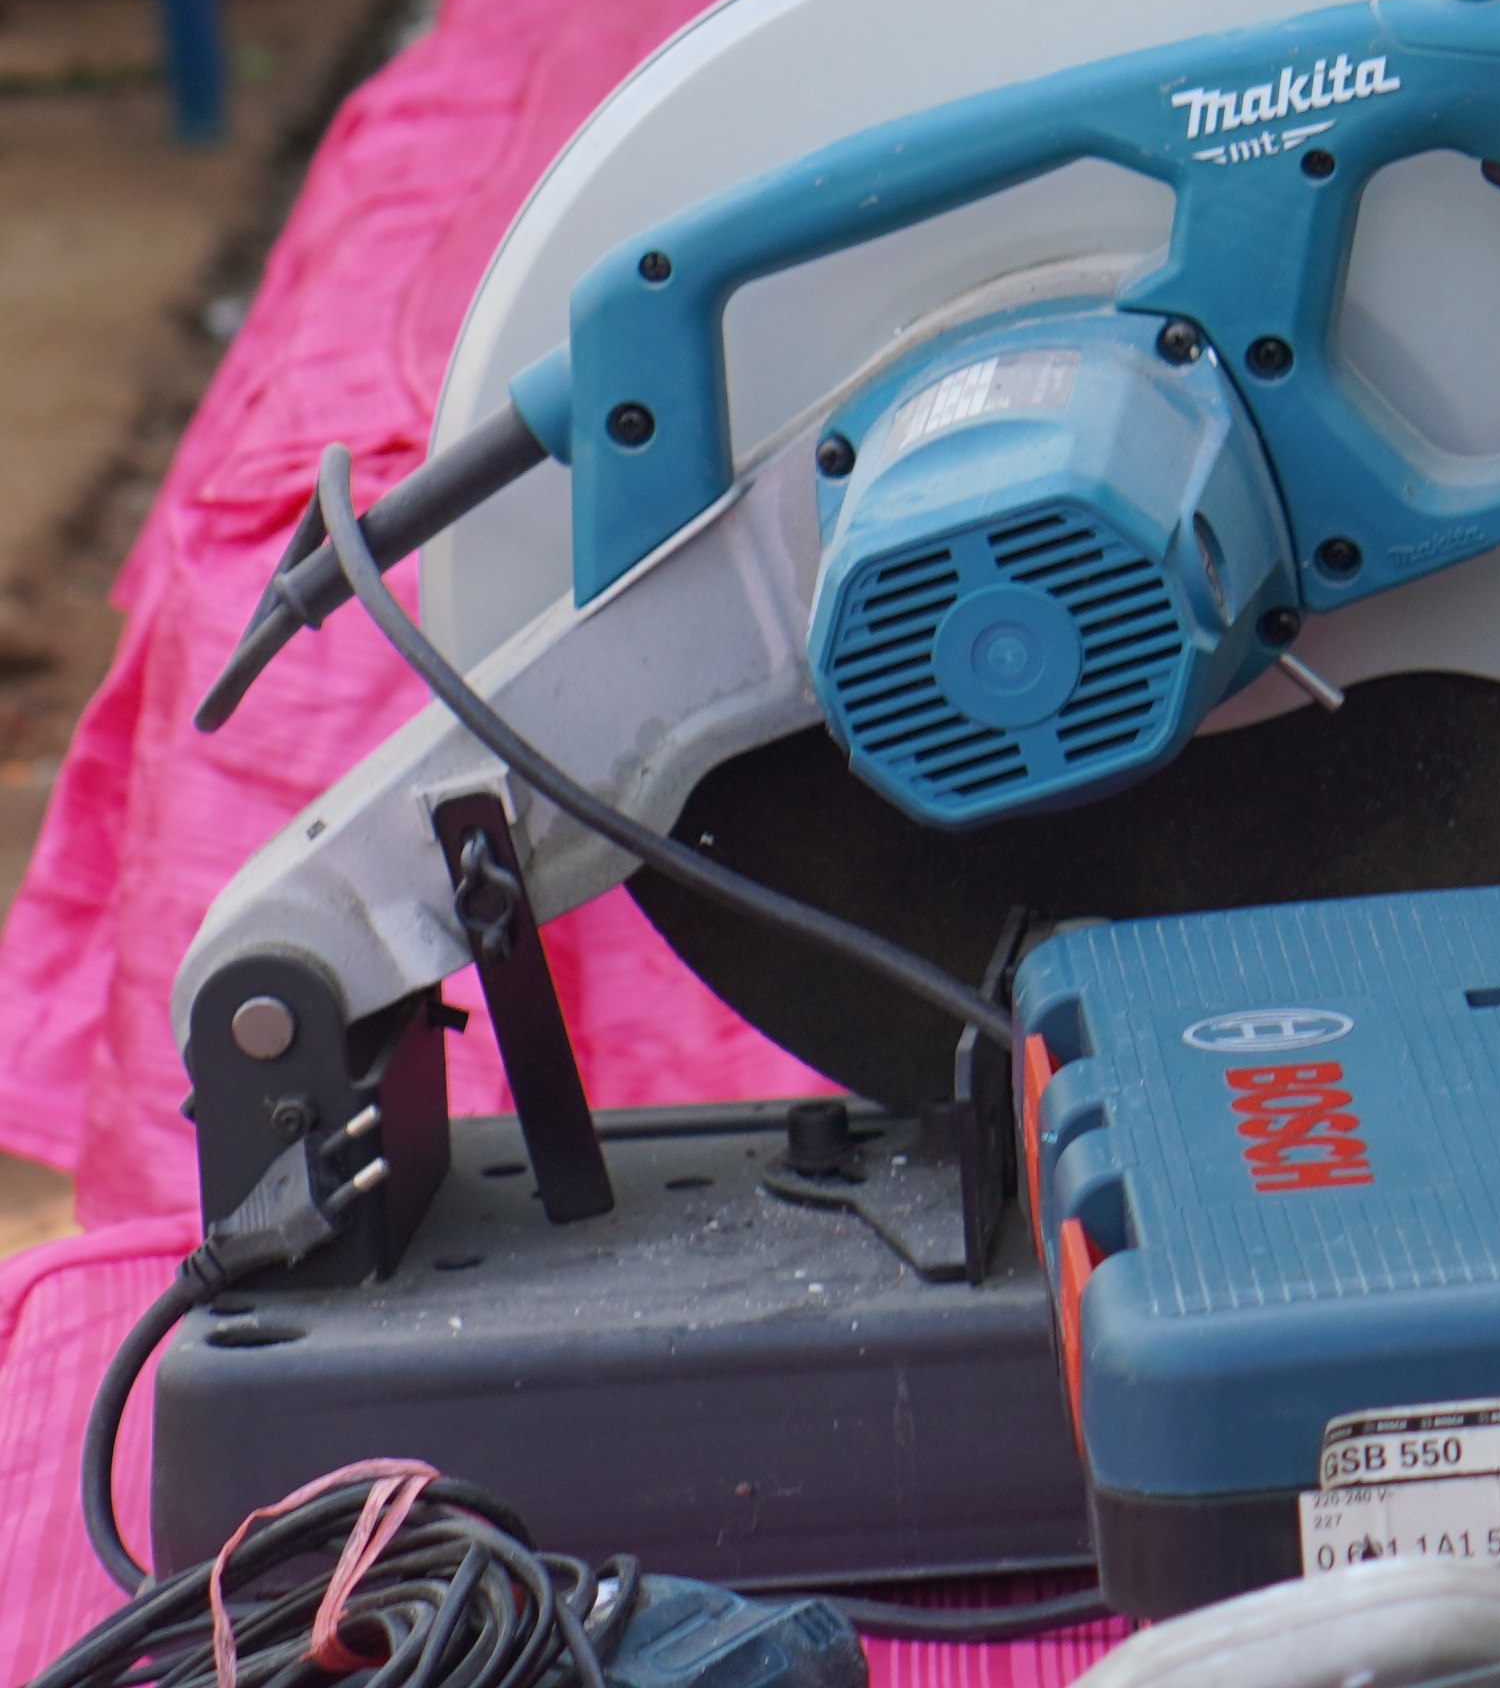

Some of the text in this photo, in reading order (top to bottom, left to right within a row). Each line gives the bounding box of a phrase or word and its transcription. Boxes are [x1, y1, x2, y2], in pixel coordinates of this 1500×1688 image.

[1171, 53, 1400, 139] makita
[1225, 1061, 1374, 1193] BOSCH
[1325, 1436, 1462, 1480] GSB 550
[1314, 1512, 1342, 1530] 227
[1318, 1544, 1334, 1571] 0
[1416, 1530, 1475, 1557] 1A1
